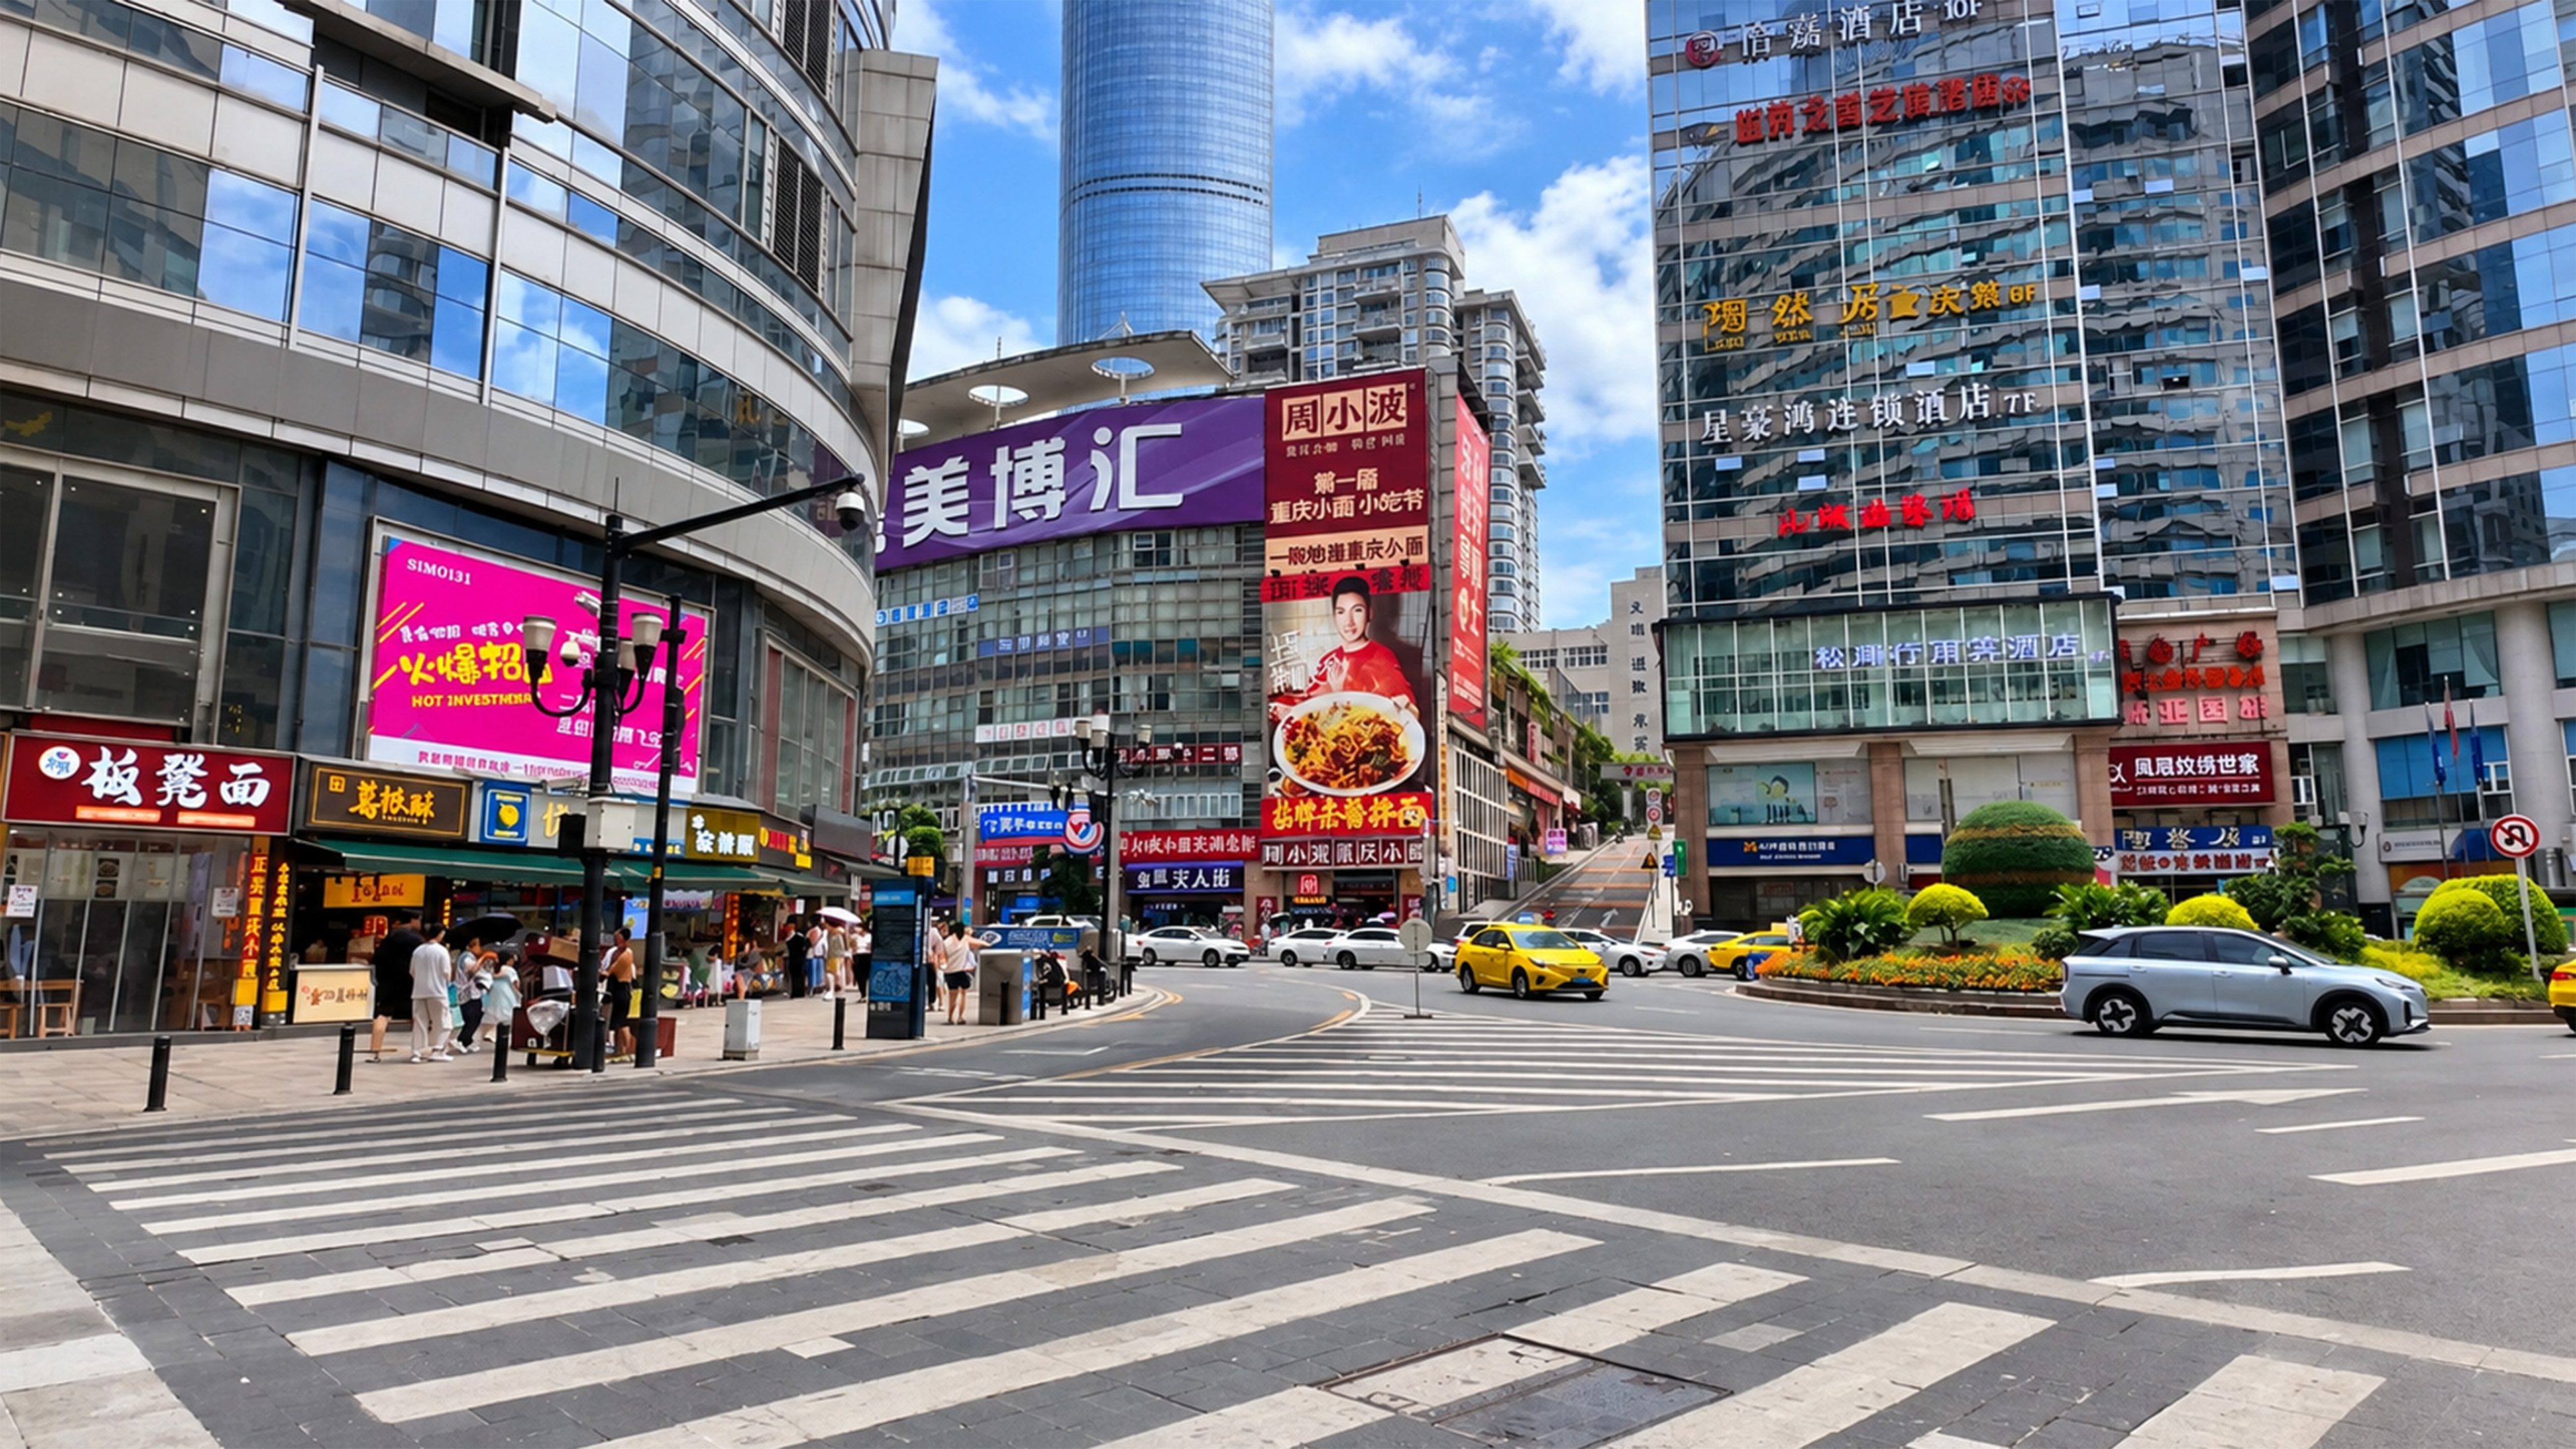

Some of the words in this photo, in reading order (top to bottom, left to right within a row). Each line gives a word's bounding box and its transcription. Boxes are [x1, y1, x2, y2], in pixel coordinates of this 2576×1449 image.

[1284, 386, 1406, 437] 周小波
[876, 422, 1184, 554] 美博汇
[412, 694, 443, 708] HOT
